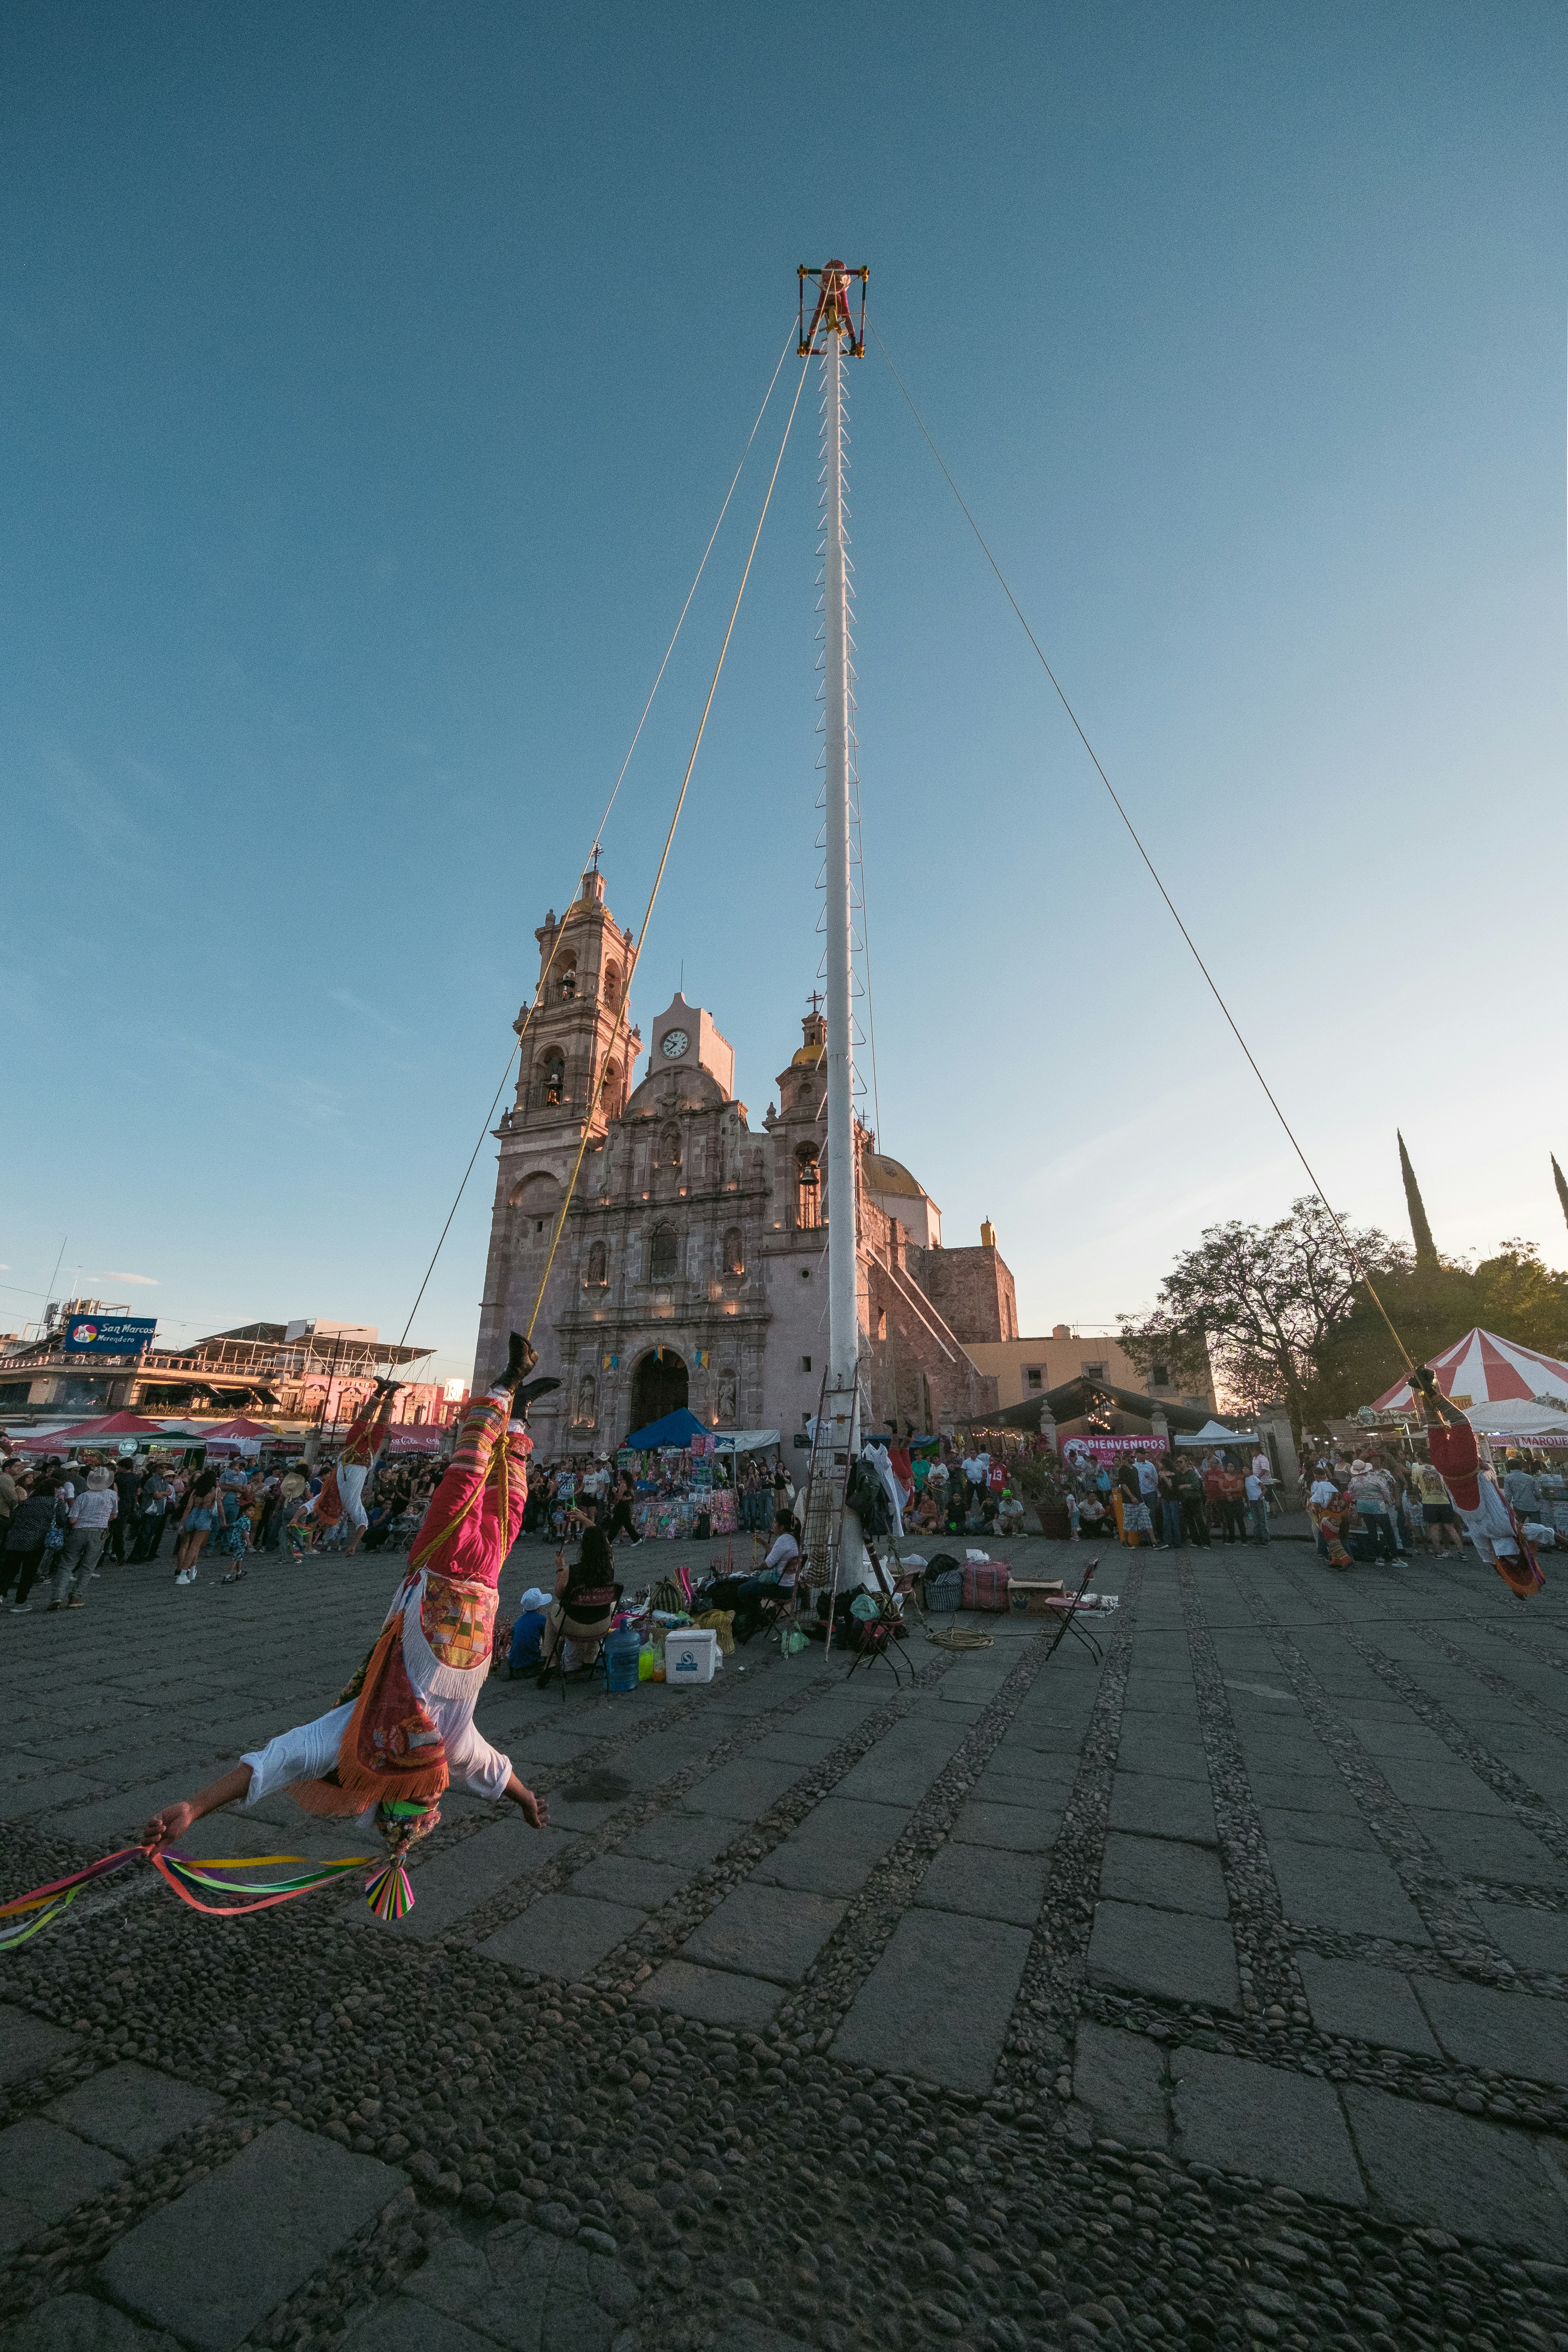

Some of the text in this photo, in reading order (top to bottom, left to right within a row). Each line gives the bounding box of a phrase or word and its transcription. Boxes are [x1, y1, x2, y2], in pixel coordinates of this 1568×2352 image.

[101, 1323, 154, 1334] San Marcos
[97, 1335, 135, 1343] Merendero
[1088, 1439, 1165, 1450] BIENVENIDOS
[992, 1469, 1002, 1481] 13
